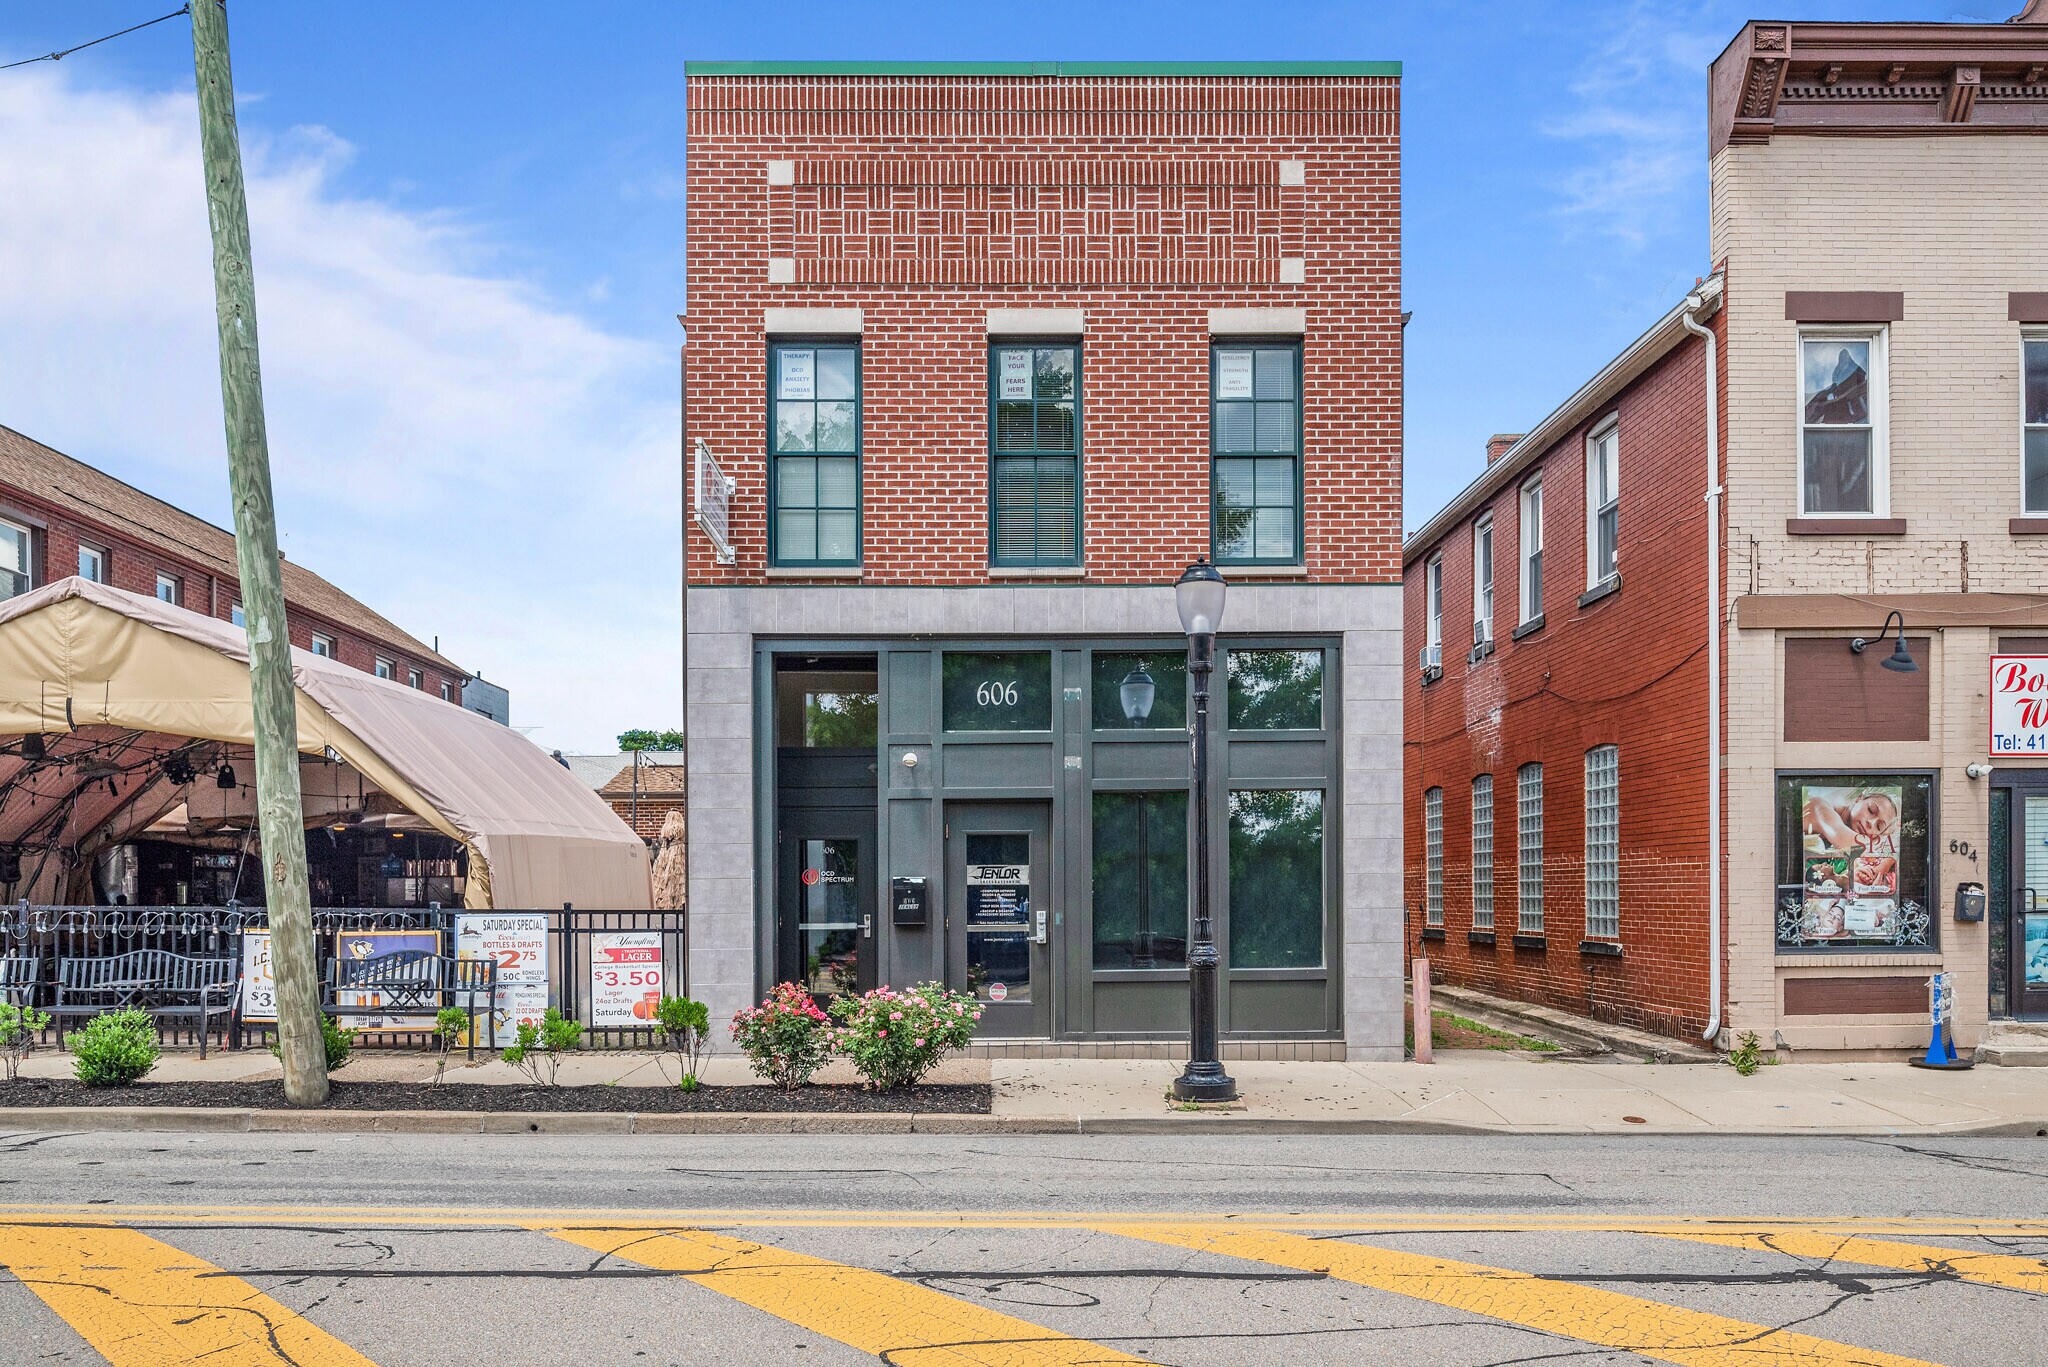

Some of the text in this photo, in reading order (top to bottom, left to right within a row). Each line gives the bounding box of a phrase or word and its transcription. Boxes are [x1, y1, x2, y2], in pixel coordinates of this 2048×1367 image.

[1995, 662, 2048, 693] Bo
[976, 680, 1018, 706] 606
[1994, 734, 2021, 750] Tel:
[1854, 833, 1898, 854] SPA
[1949, 838, 1978, 863] 604
[482, 919, 543, 931] SATURDAY SPECIAL
[482, 941, 510, 949] BOTTLES
[616, 935, 656, 947] Yuengling
[621, 953, 653, 961] LAGER
[594, 971, 660, 987] $3.50
[595, 1008, 632, 1017] Saturday
